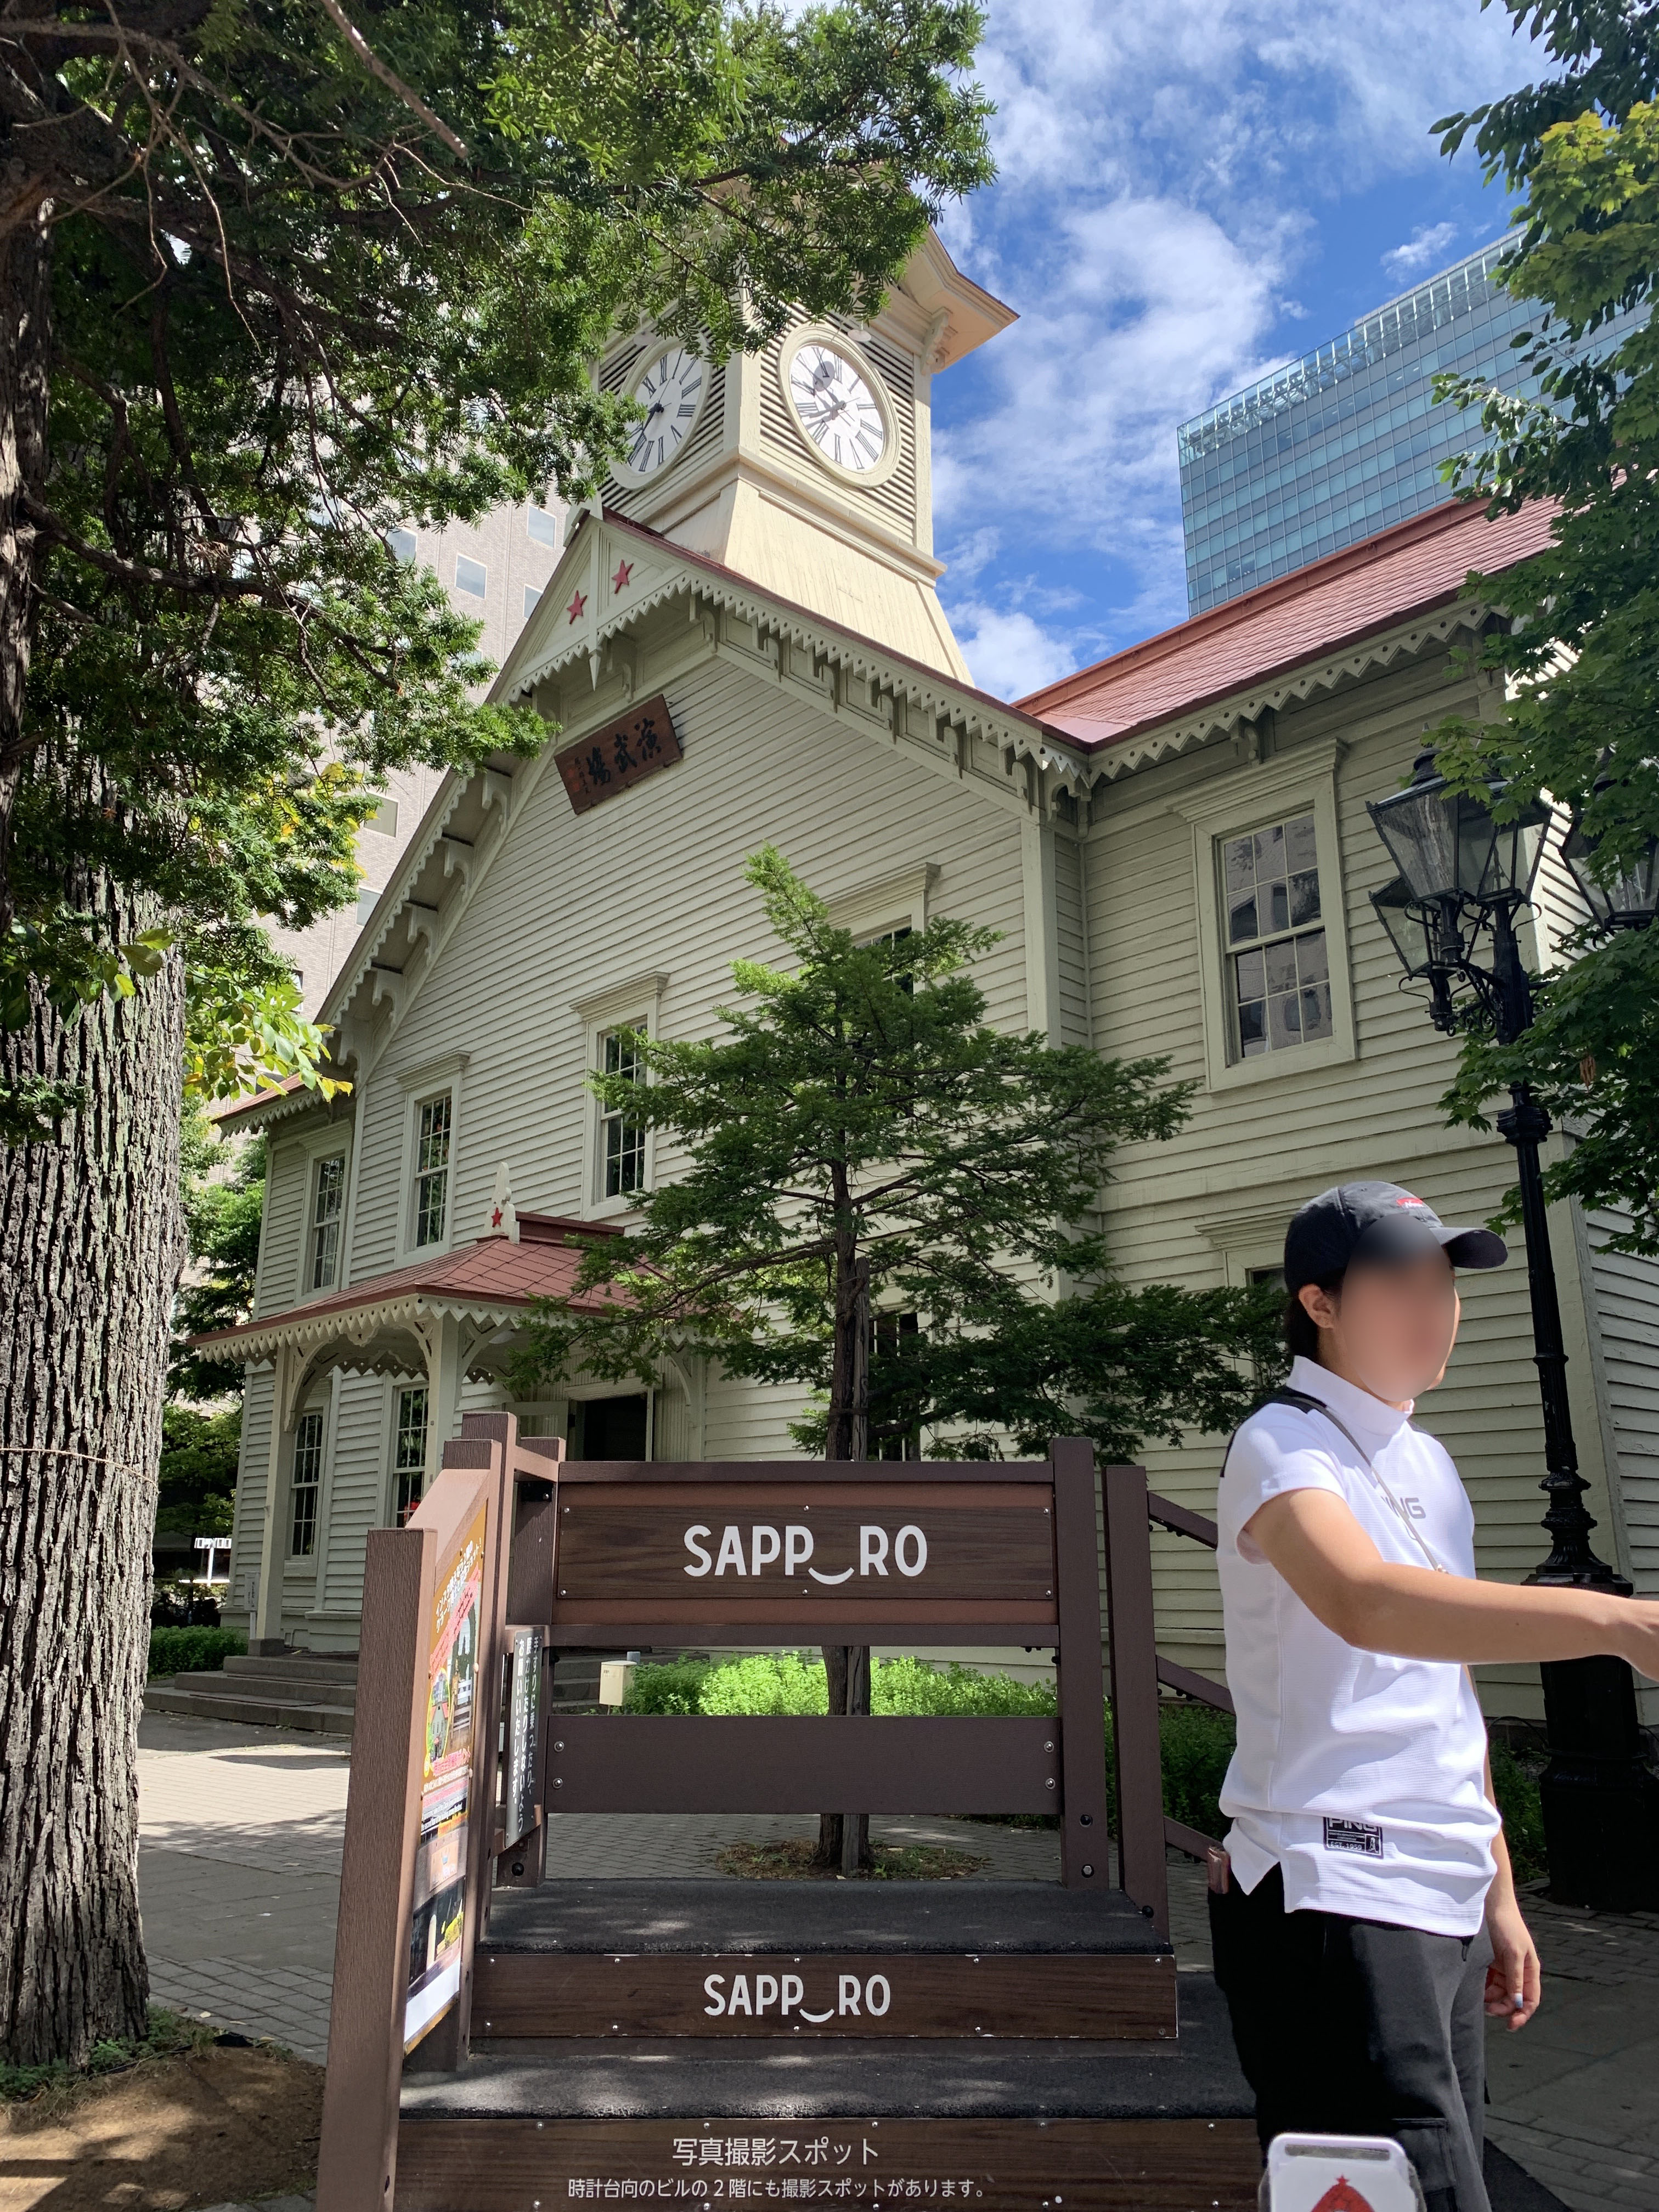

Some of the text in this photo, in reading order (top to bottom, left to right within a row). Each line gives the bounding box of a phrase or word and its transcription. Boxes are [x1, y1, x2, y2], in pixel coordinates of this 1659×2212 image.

[673, 2136, 878, 2166] 写真撮影スポット
